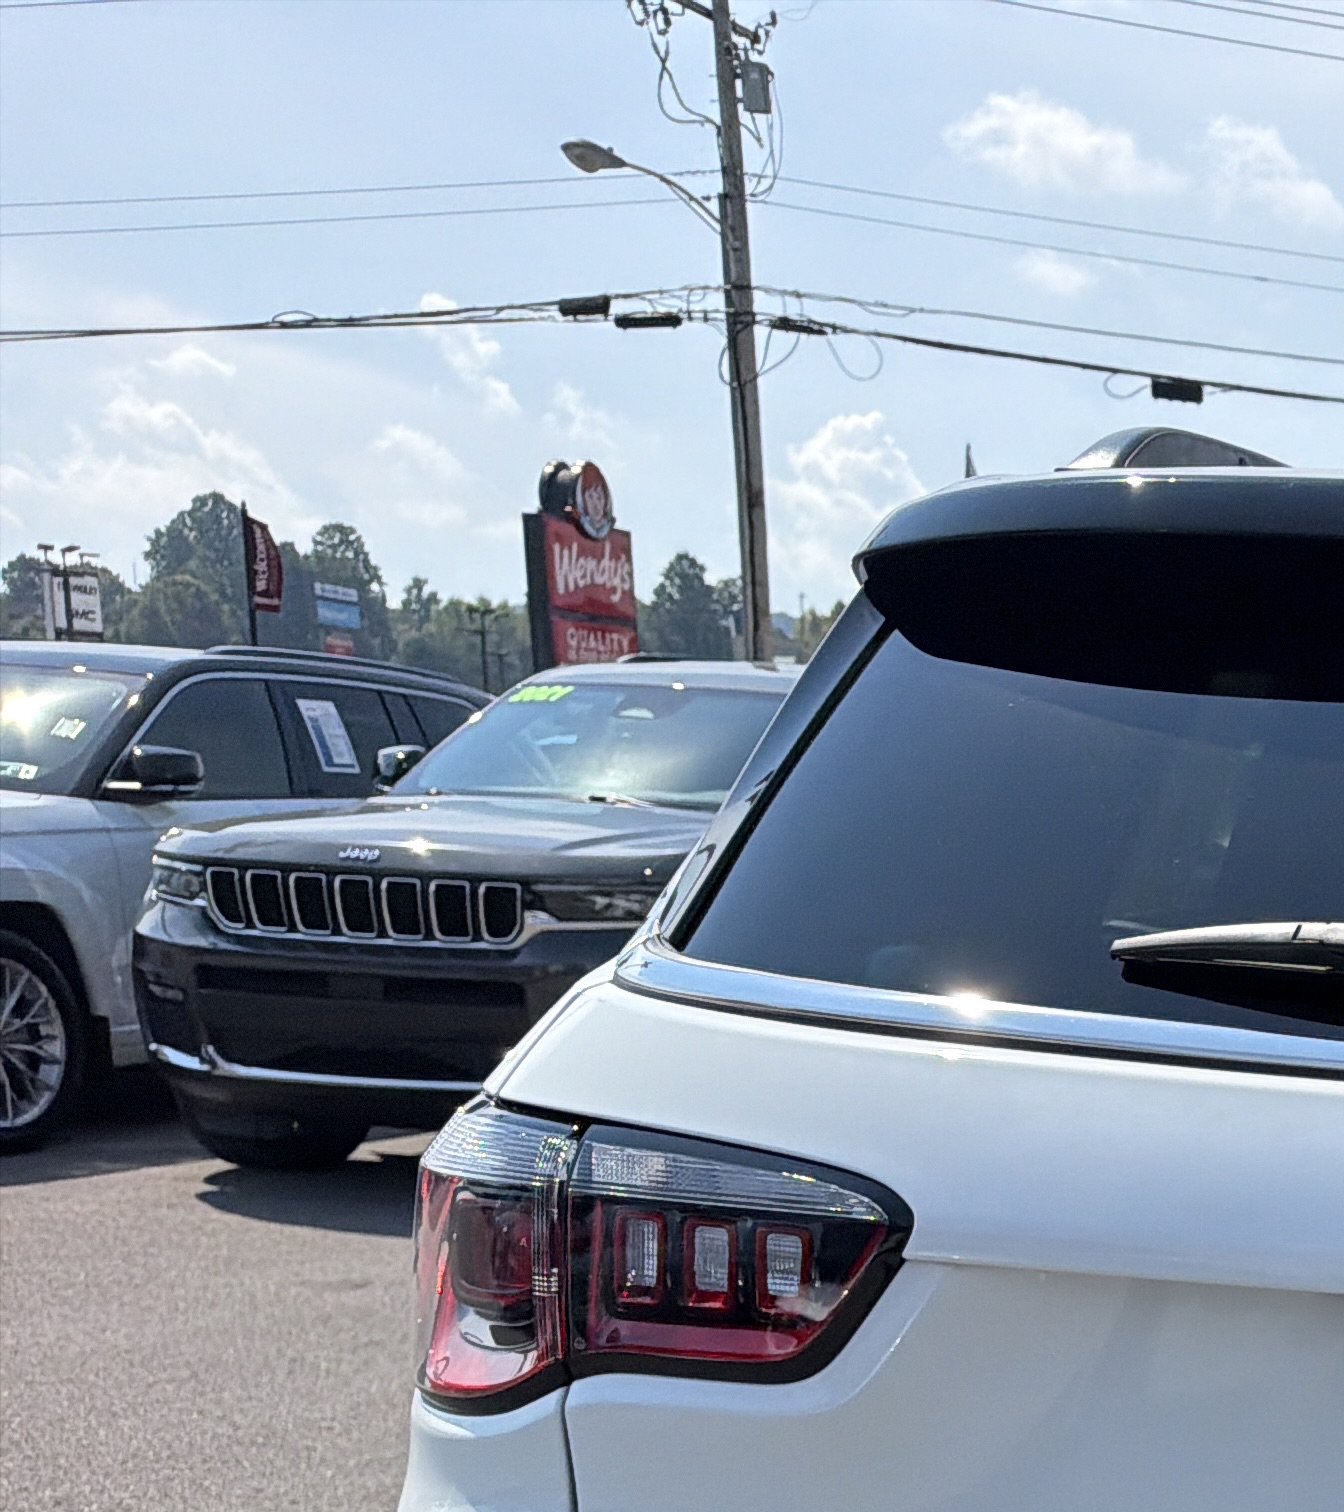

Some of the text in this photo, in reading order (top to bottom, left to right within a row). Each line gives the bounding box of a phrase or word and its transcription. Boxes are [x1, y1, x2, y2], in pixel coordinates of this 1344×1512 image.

[553, 541, 631, 603] Wendy's
[567, 627, 631, 652] QUALITY
[339, 845, 380, 860] Jeep
